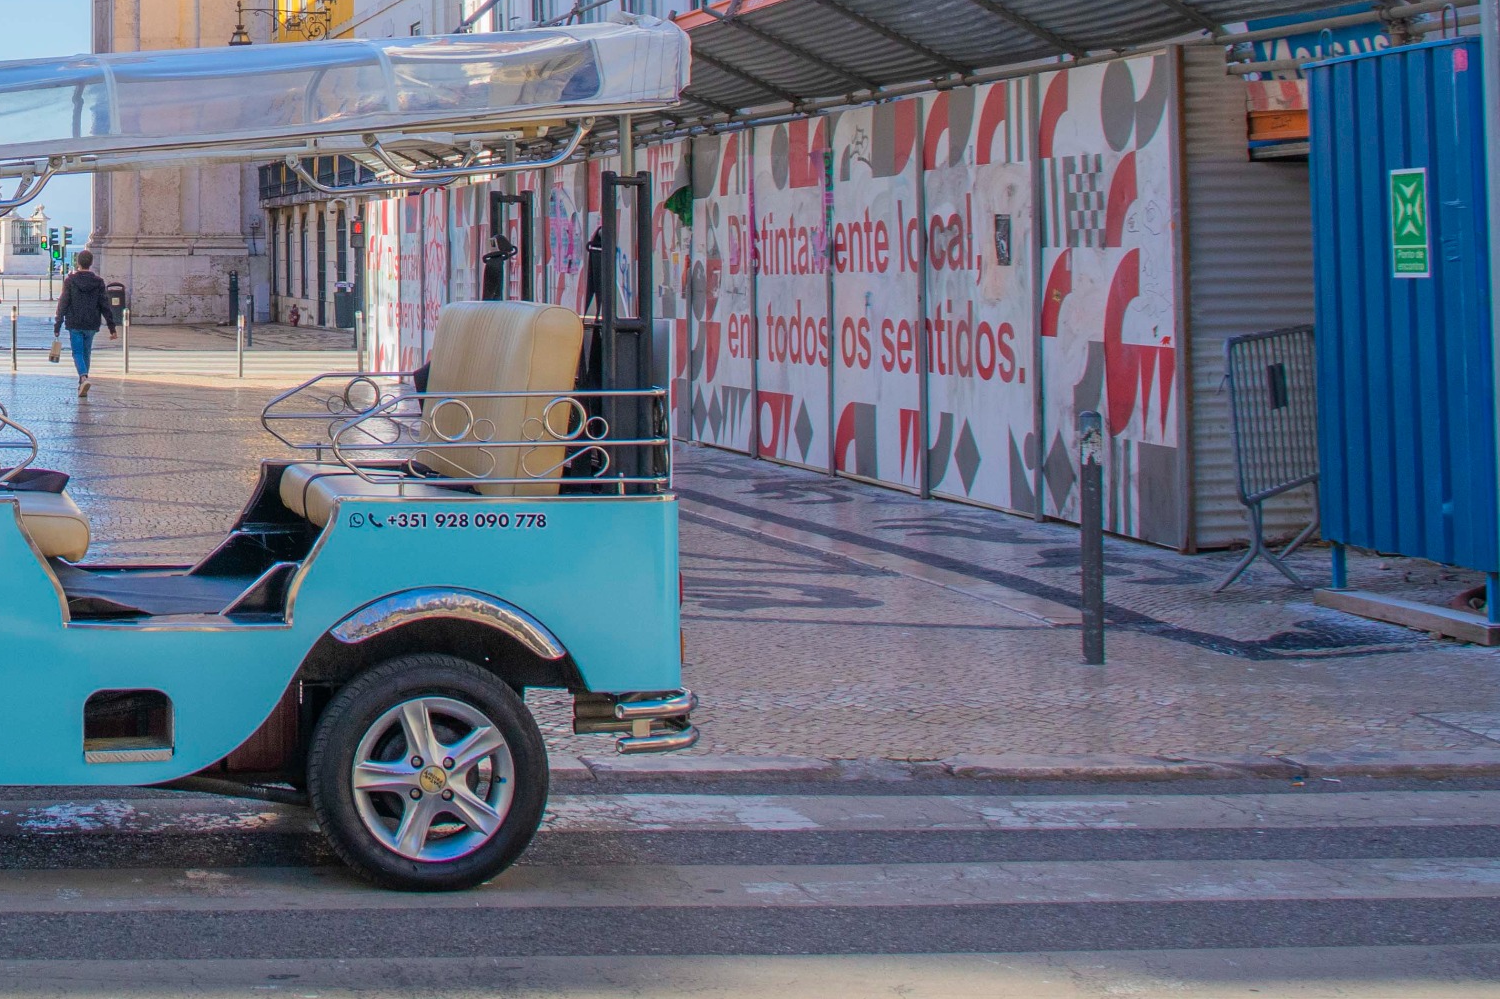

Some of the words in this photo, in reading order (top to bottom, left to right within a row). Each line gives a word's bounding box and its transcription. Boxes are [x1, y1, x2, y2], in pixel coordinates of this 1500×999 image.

[897, 193, 983, 286] local,
[416, 301, 440, 331] snse
[728, 313, 760, 360] en
[766, 300, 828, 367] todos
[841, 316, 872, 370] os
[881, 299, 1026, 384] sentidos.
[387, 513, 427, 529] +351
[434, 513, 469, 529] 928
[474, 513, 510, 529] 090
[515, 513, 547, 529] 778
